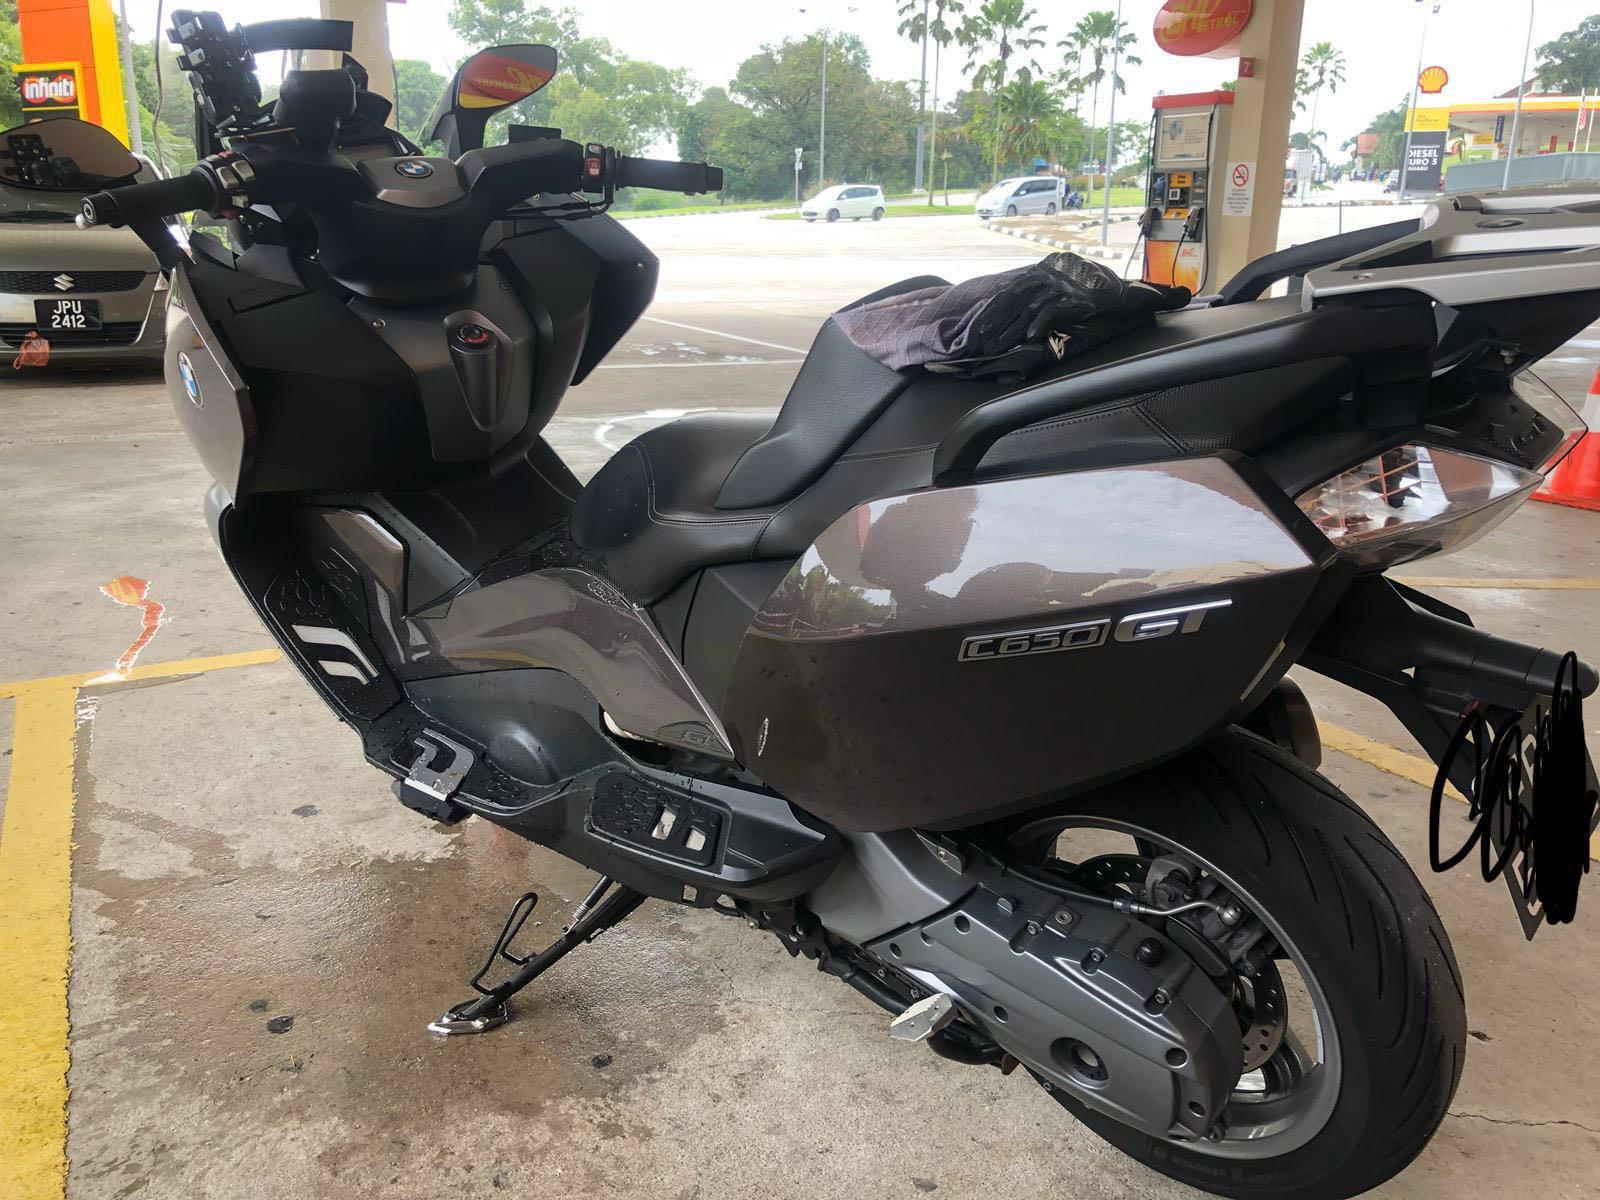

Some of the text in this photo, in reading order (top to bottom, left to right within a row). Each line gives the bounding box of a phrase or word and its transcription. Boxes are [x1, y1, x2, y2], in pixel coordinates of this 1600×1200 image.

[1408, 158, 1438, 166] URO 5
[53, 300, 82, 314] JPU
[51, 314, 86, 329] 2412
[967, 598, 1233, 658] C650 GT
